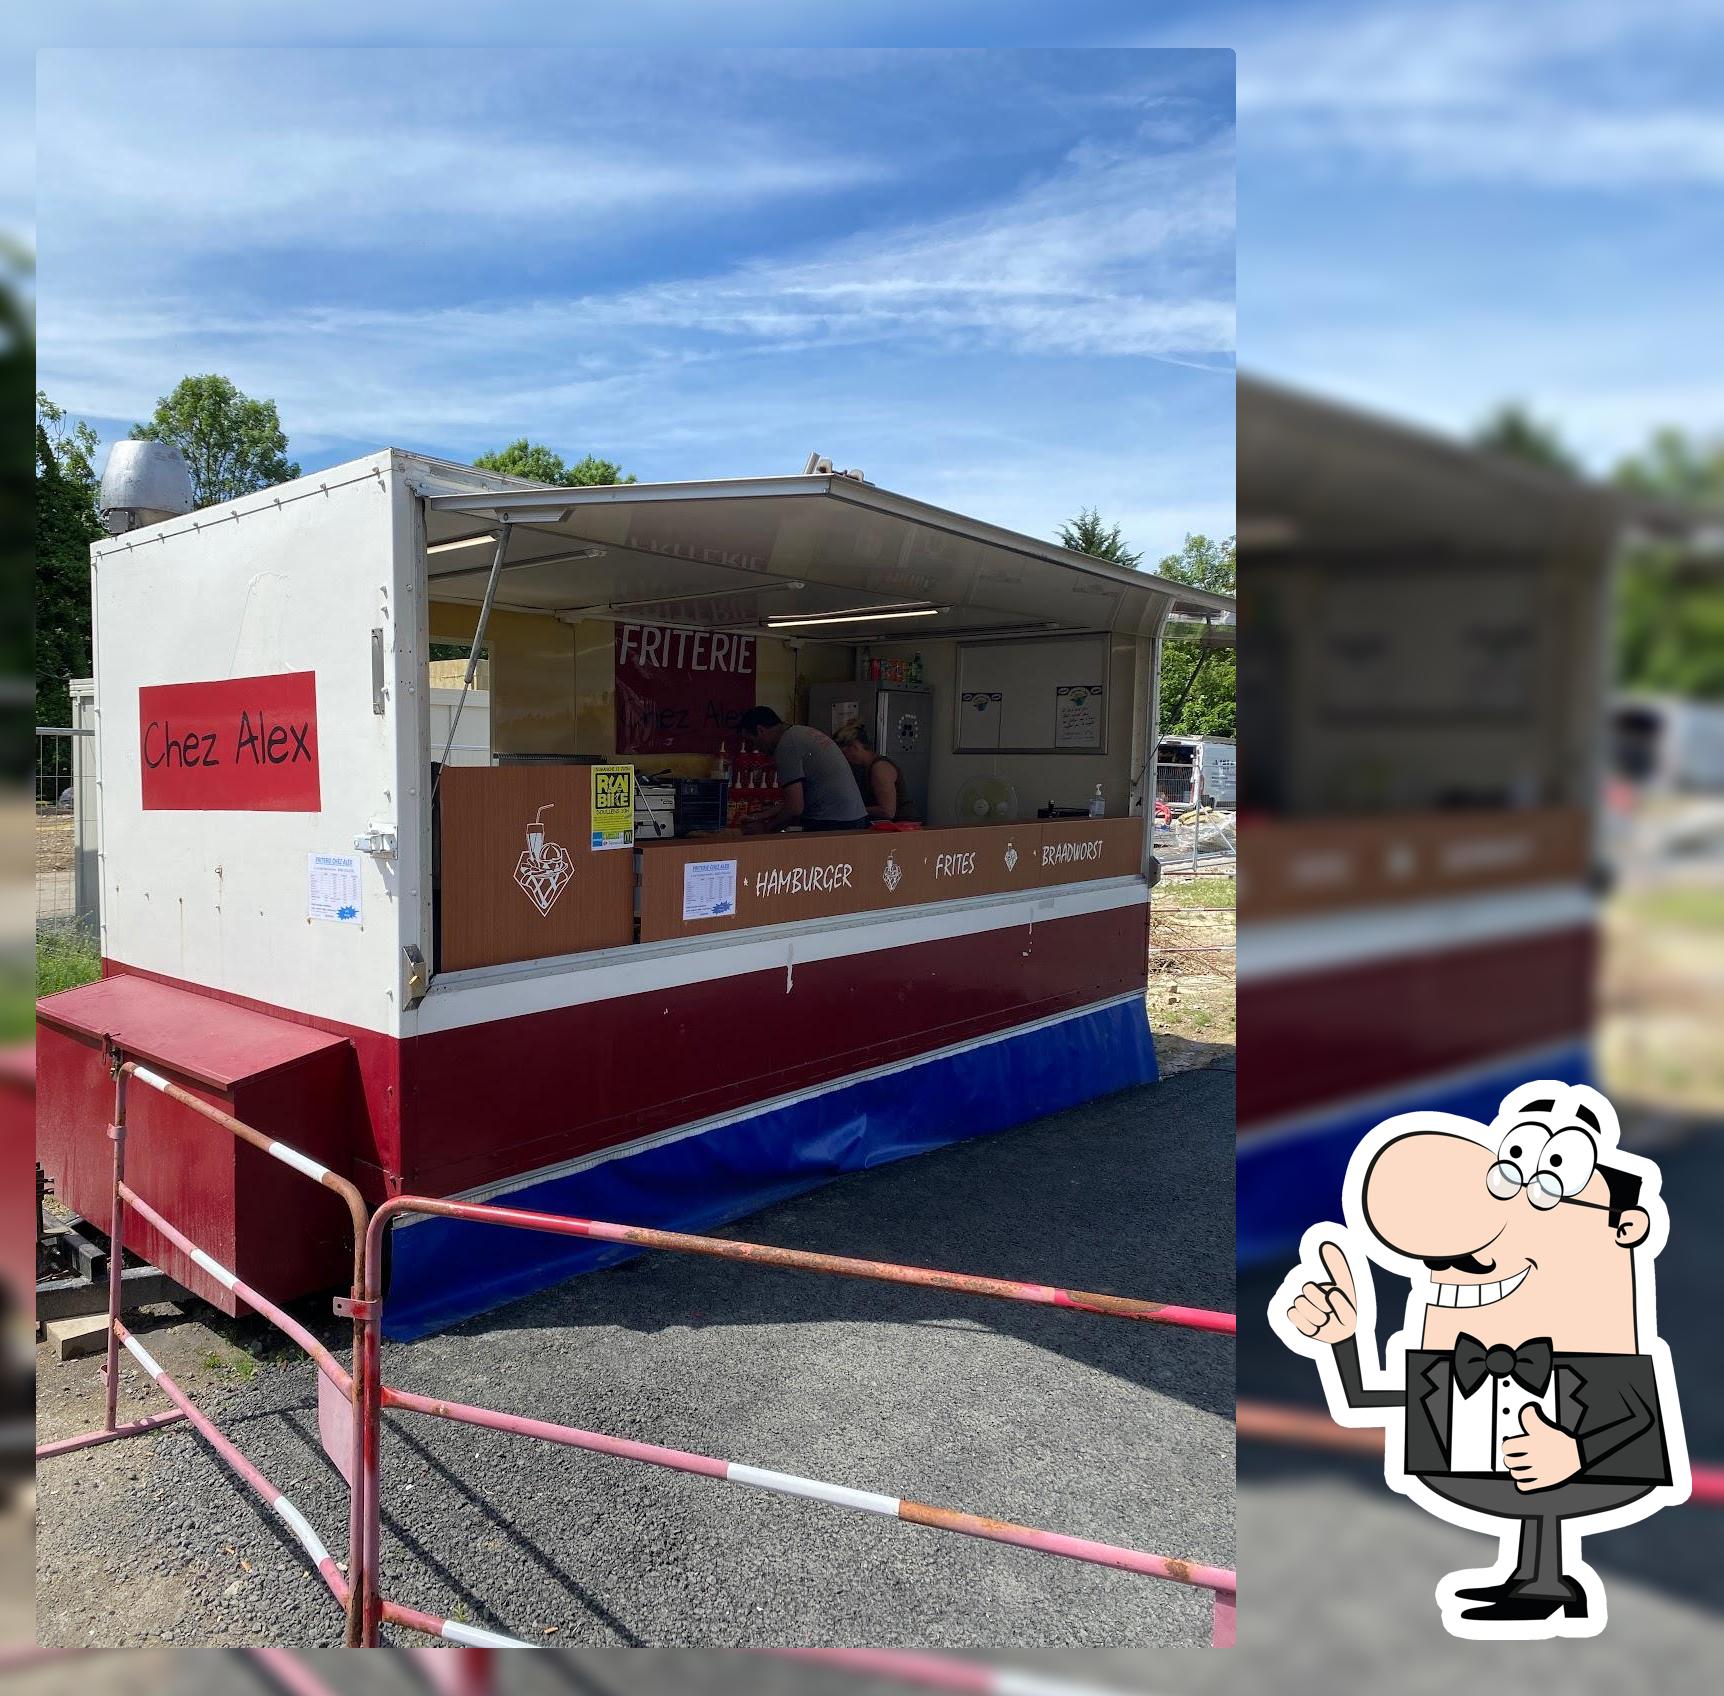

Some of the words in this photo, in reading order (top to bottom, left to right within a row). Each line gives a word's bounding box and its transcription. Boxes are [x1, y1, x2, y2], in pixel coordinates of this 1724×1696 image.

[620, 625, 756, 674] FRITERIE
[144, 720, 220, 769] Chez
[236, 710, 312, 764] Alex
[597, 793, 629, 808] BIKE
[935, 851, 976, 879] FRITES
[1042, 840, 1104, 867] BRAADWORST
[755, 863, 853, 897] HAMBURGER
